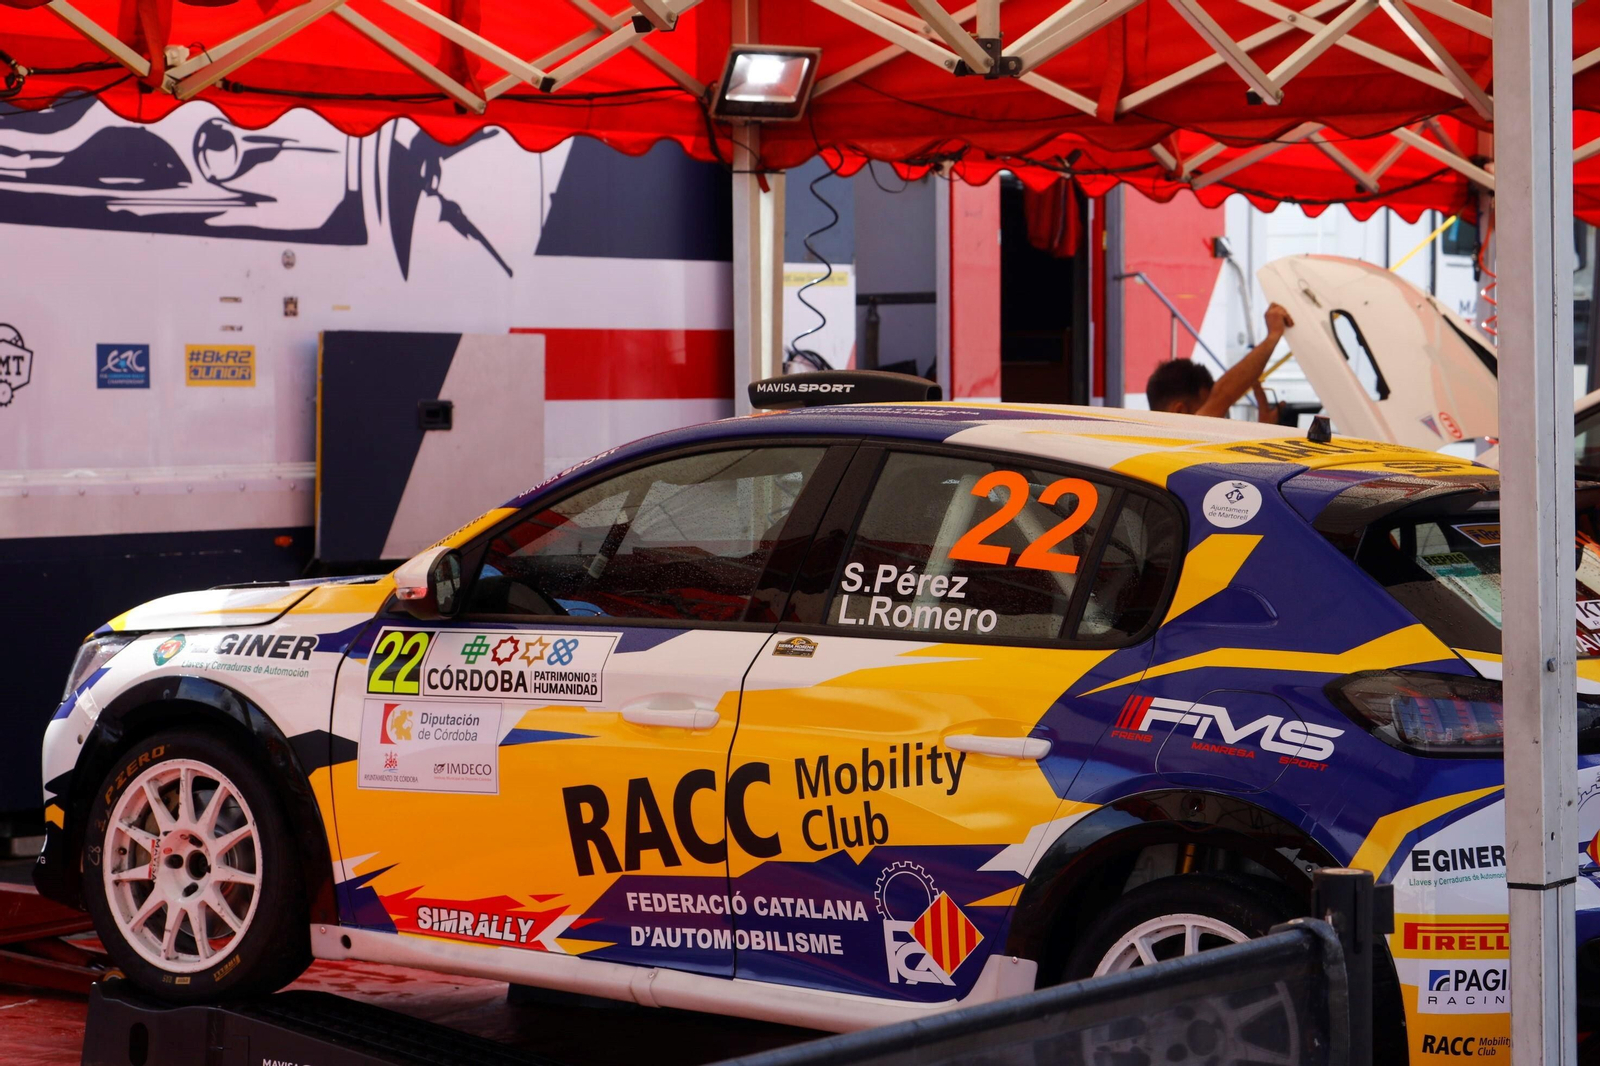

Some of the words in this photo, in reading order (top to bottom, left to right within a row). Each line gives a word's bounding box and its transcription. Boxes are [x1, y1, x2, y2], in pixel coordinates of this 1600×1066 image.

[756, 383, 797, 393] MAVISA
[798, 383, 855, 393] SPORT
[518, 475, 559, 499] MAVISA
[559, 446, 620, 478] SPORT
[1208, 510, 1217, 518] de
[1217, 511, 1249, 521] Martorell
[1210, 504, 1249, 515] Ajuntament
[948, 470, 1098, 574] 22
[841, 562, 969, 599] S.Pérez
[838, 594, 998, 633] L.Romero
[181, 660, 204, 670] Llaves
[211, 661, 252, 673] Cerraduras
[253, 665, 263, 674] de
[264, 665, 310, 678] Automoción
[368, 631, 430, 694] 22
[427, 665, 528, 693] CÓRDOBA
[534, 671, 590, 683] PATRIMONIO
[533, 682, 598, 696] HUMANIDAD
[420, 712, 480, 727] Diputación
[1138, 697, 1346, 761] FMS
[417, 728, 431, 740] de
[433, 728, 478, 742] Córdoba
[1110, 730, 1153, 743] FRENS
[1191, 741, 1256, 759] MANRESA
[446, 763, 492, 776] IMDECO
[793, 741, 967, 800] Mobility
[1278, 756, 1329, 772] SPORT
[562, 762, 782, 878] RACC
[801, 801, 890, 852] Club
[1411, 845, 1507, 872] EGINER
[1409, 878, 1432, 887] Llaves
[1438, 875, 1472, 886] Cerraduras
[1472, 873, 1480, 881] de
[626, 891, 748, 916] FEDERACIÓ
[754, 896, 869, 922] CATALANA
[417, 905, 535, 944] SIMRALLY
[1454, 969, 1509, 992] PAGI
[1422, 1034, 1476, 1057] RACC
[1477, 1047, 1497, 1056] Club
